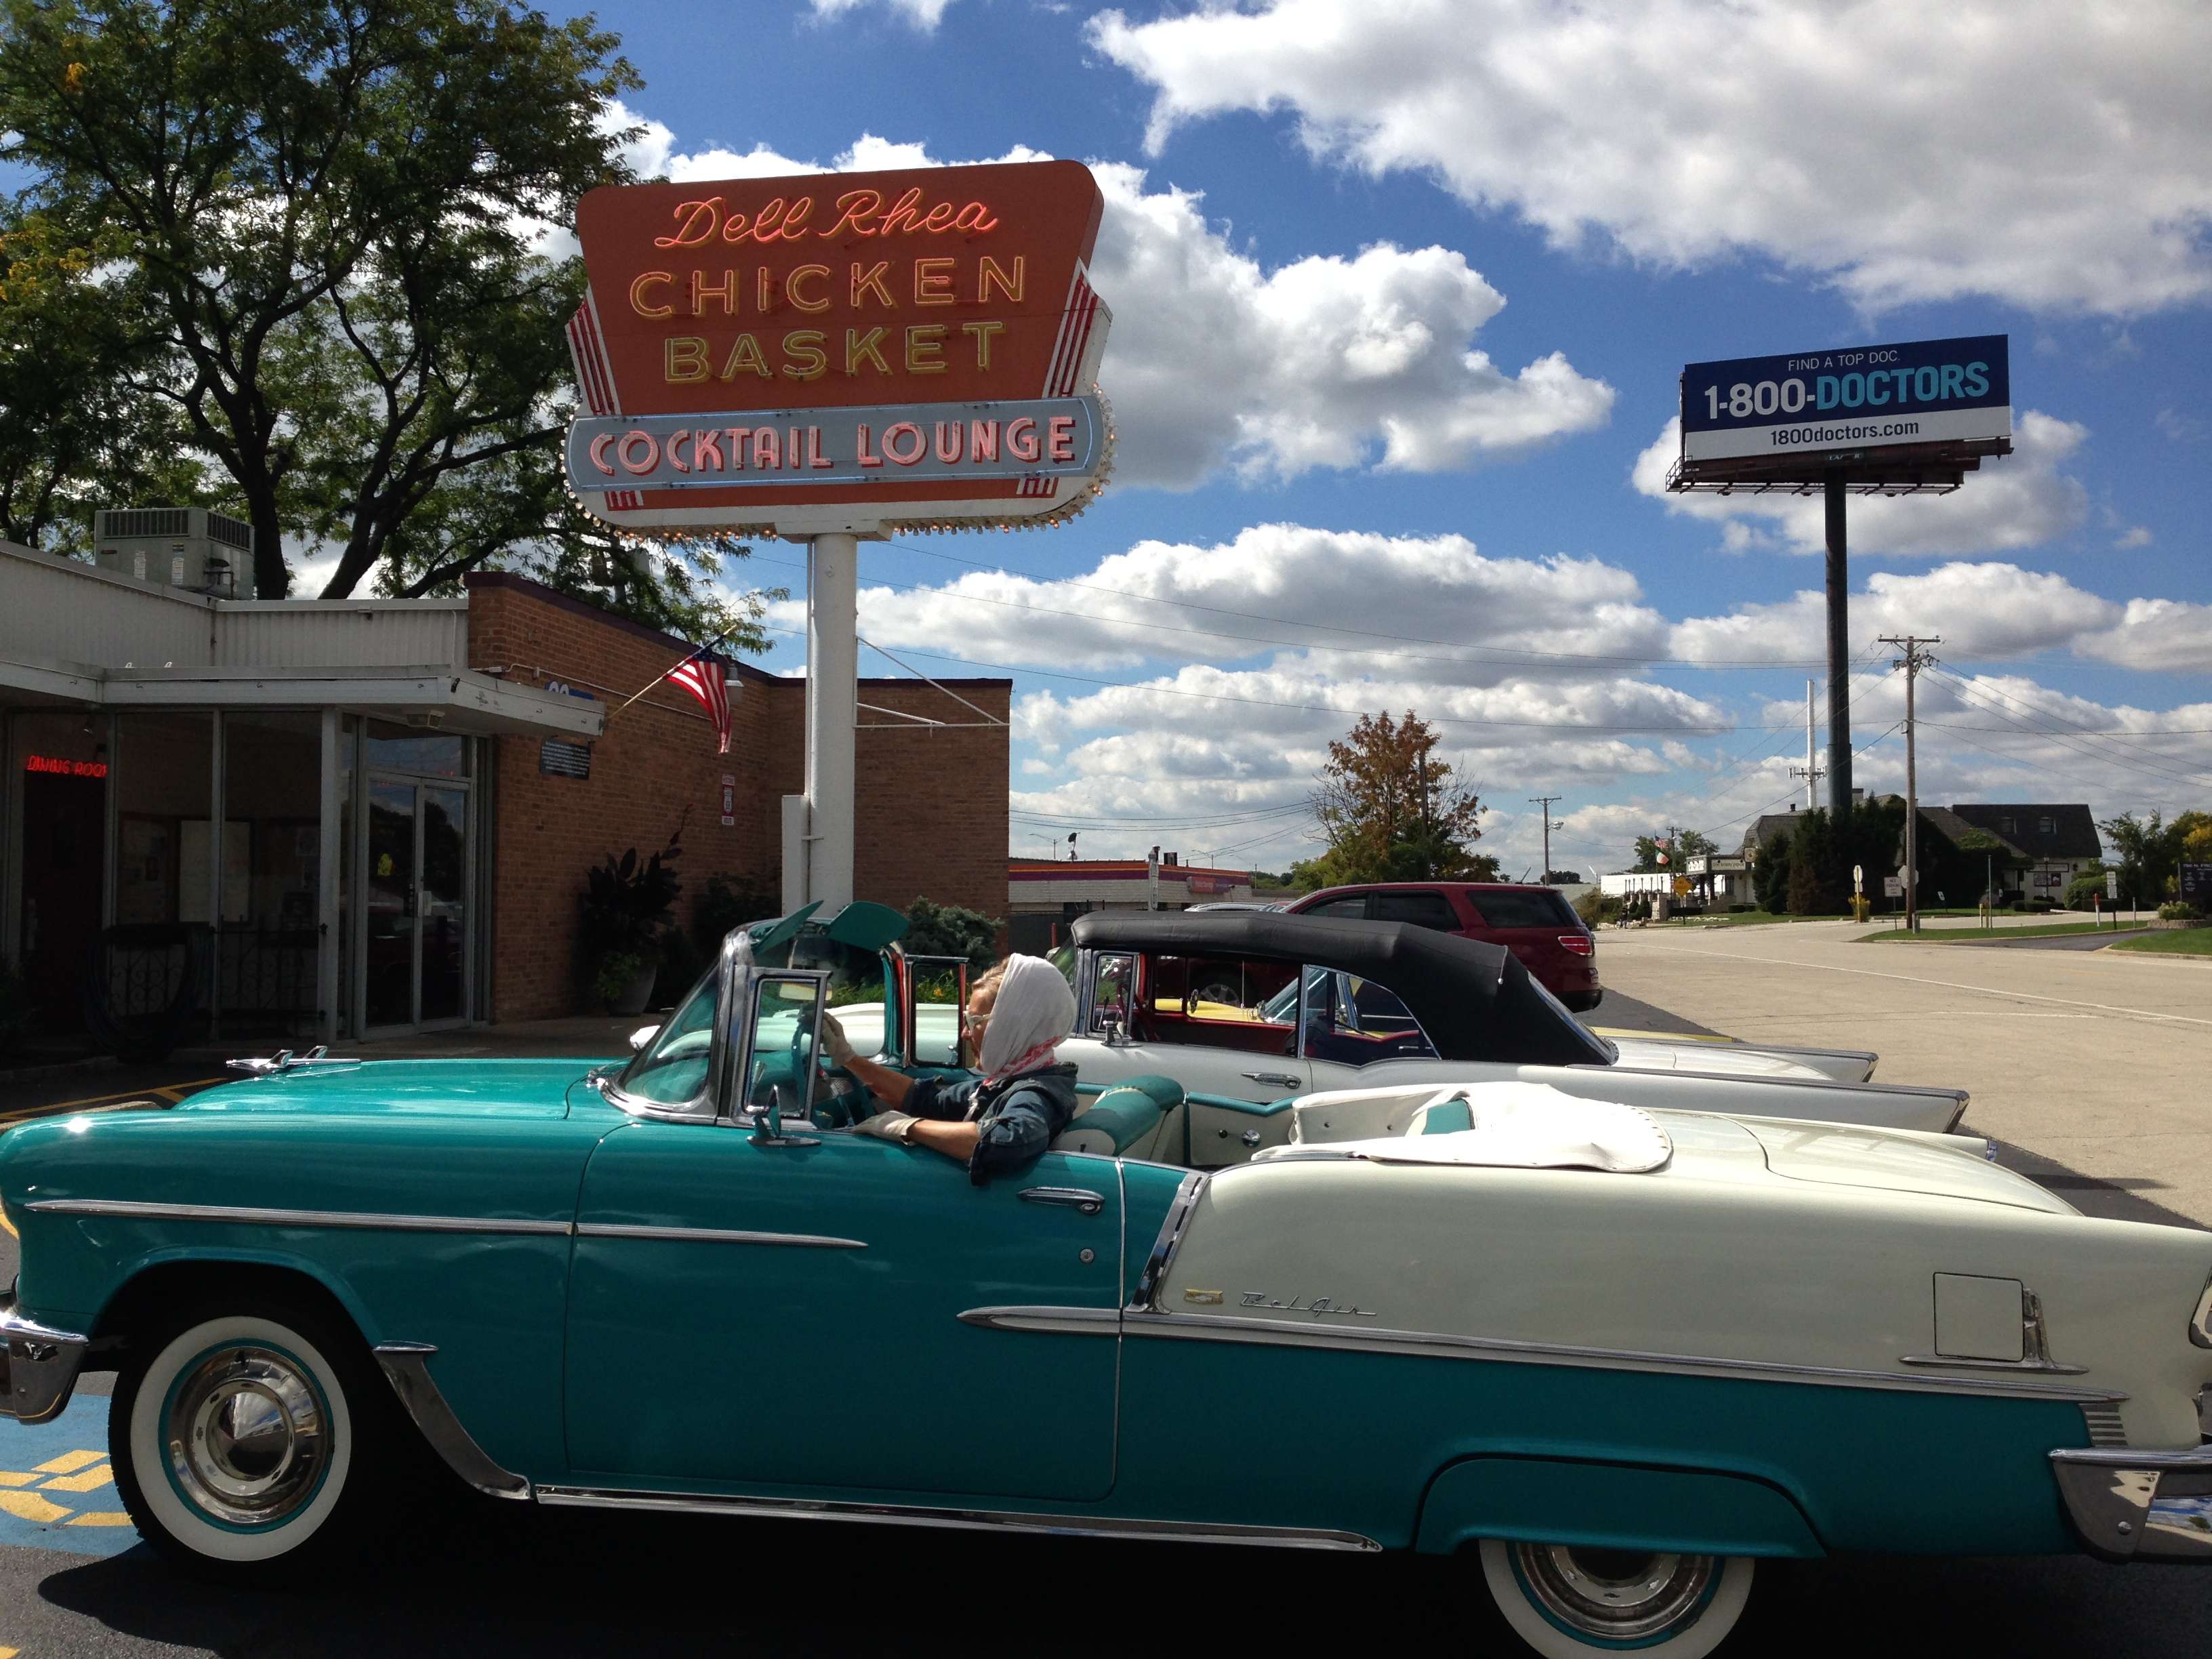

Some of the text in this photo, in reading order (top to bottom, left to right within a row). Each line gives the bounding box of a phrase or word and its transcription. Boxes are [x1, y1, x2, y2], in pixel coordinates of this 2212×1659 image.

[654, 186, 998, 249] Dell Rhea
[630, 255, 1026, 319] CHICKEN
[664, 321, 1006, 384] BASKET
[1788, 358, 1820, 371] FIND
[1824, 356, 1833, 368] A
[1838, 353, 1864, 366] TOP
[1704, 361, 1990, 419] 1-800-DOCTORS
[590, 415, 1076, 476] COCKTAIL LOUNGE
[1771, 420, 1919, 446] 1800doctors.com
[27, 755, 70, 773] DINING
